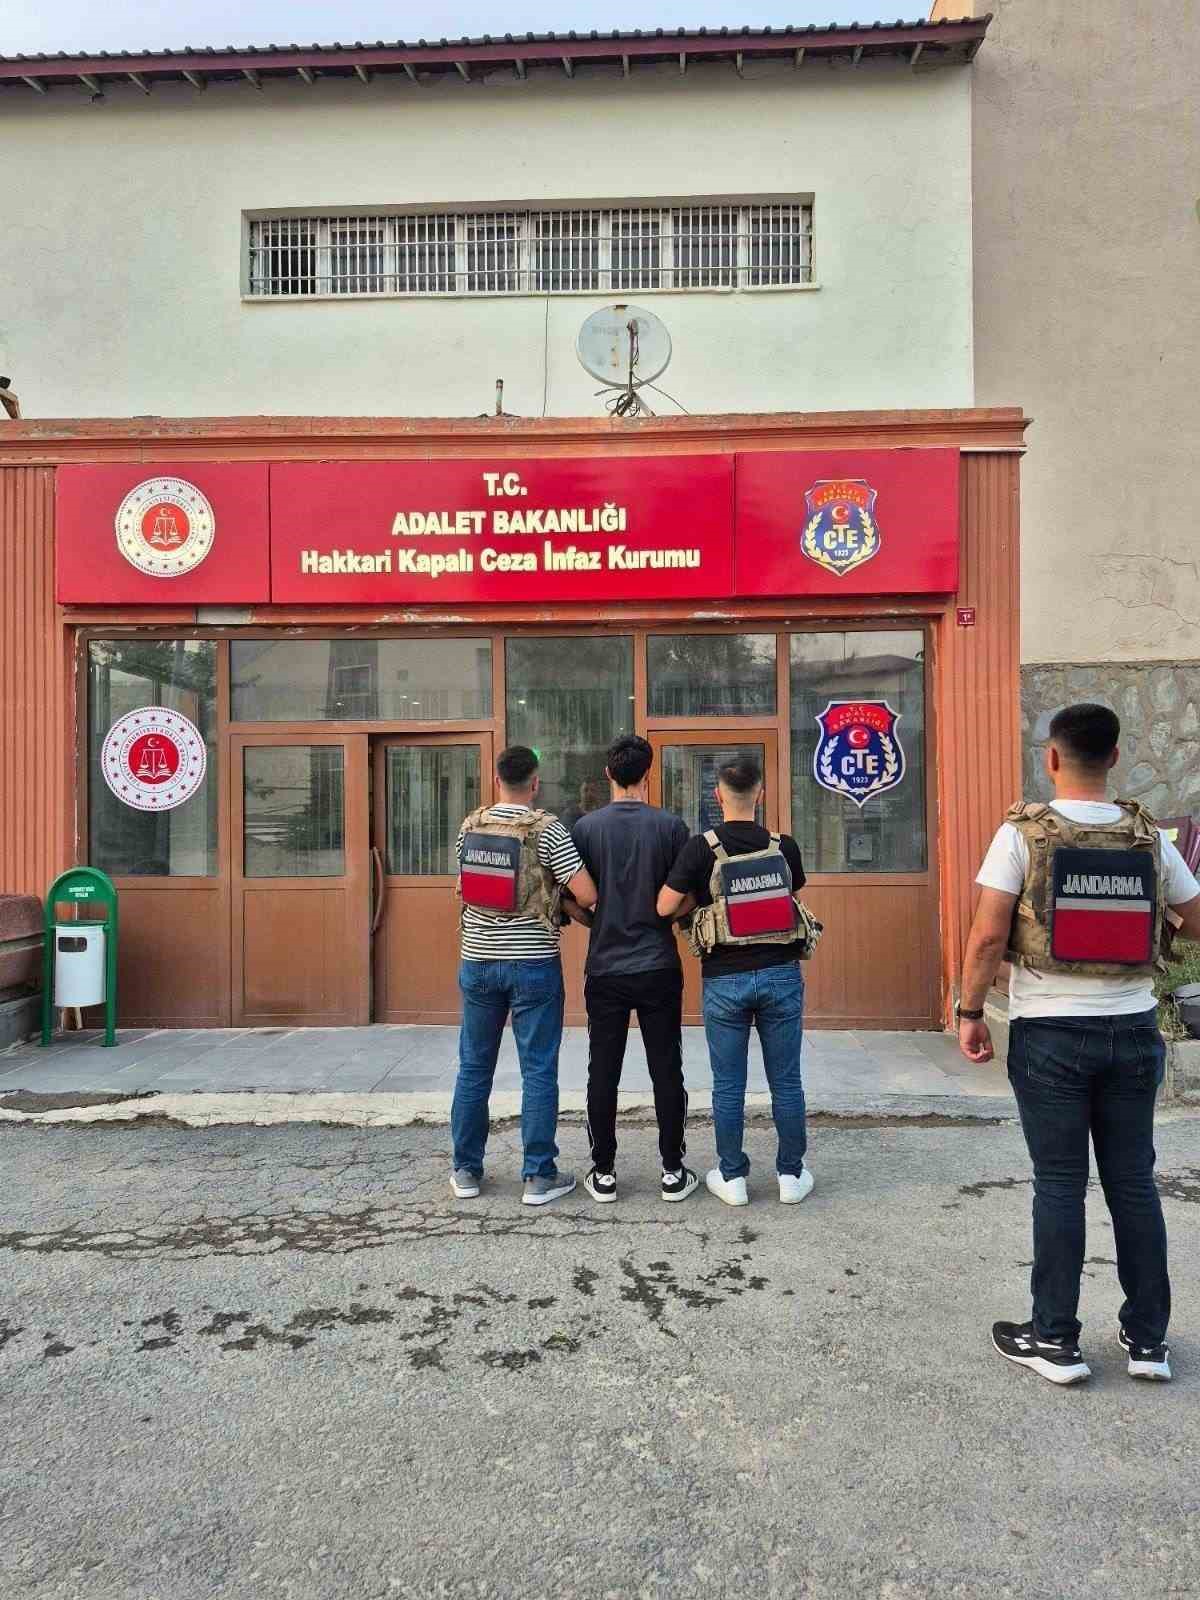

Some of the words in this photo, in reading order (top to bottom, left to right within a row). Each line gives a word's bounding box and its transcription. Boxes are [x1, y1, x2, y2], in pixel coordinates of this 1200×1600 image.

[483, 472, 528, 496] T.C.
[391, 511, 486, 535] ADALET
[493, 503, 626, 534] BAKANLIĞI
[823, 524, 858, 549] CTE
[301, 549, 391, 575] Hakkari
[398, 548, 473, 578] Kapalı
[480, 548, 537, 571] Ceza
[544, 541, 601, 571] İnfaz
[608, 546, 700, 570] Kurumu
[841, 749, 879, 775] CTE
[730, 872, 784, 893] JANDARMA
[1062, 874, 1144, 896] JANDARMA
